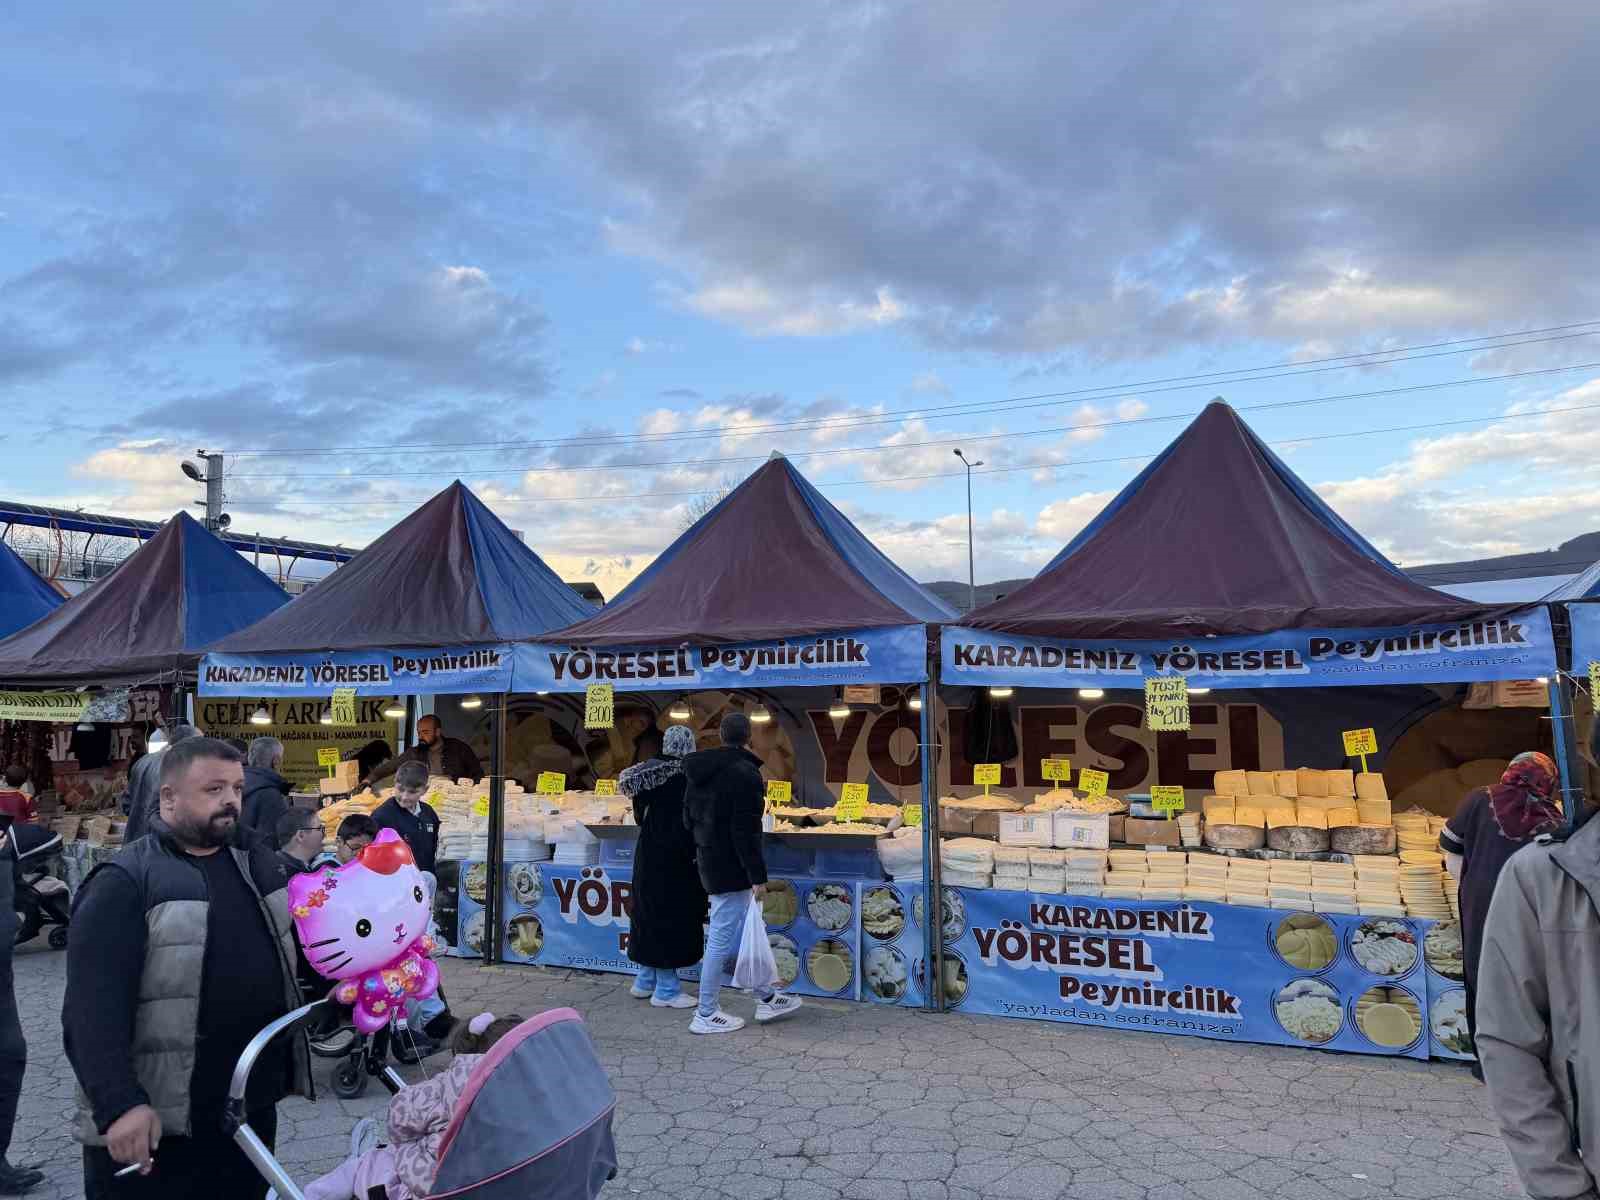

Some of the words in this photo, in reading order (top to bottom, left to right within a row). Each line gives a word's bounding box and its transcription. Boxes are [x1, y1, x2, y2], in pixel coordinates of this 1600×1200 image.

[549, 645, 696, 680] YÖRESEL
[700, 638, 866, 671] Peynircilik
[954, 643, 1140, 671] KARADENİZ
[1151, 646, 1304, 673] YÖRESEL
[1308, 619, 1526, 659] Peynircilik
[205, 661, 305, 684] KARADENİZ
[311, 660, 391, 684] YÖRESEL
[392, 648, 501, 675] Peynircilik
[1151, 680, 1183, 692] TOST
[203, 698, 279, 729] ÇELEİ
[1029, 903, 1212, 936] KARADENİZ
[971, 919, 1158, 974] YÖRESEL
[1059, 976, 1240, 1015] Peynircilik
